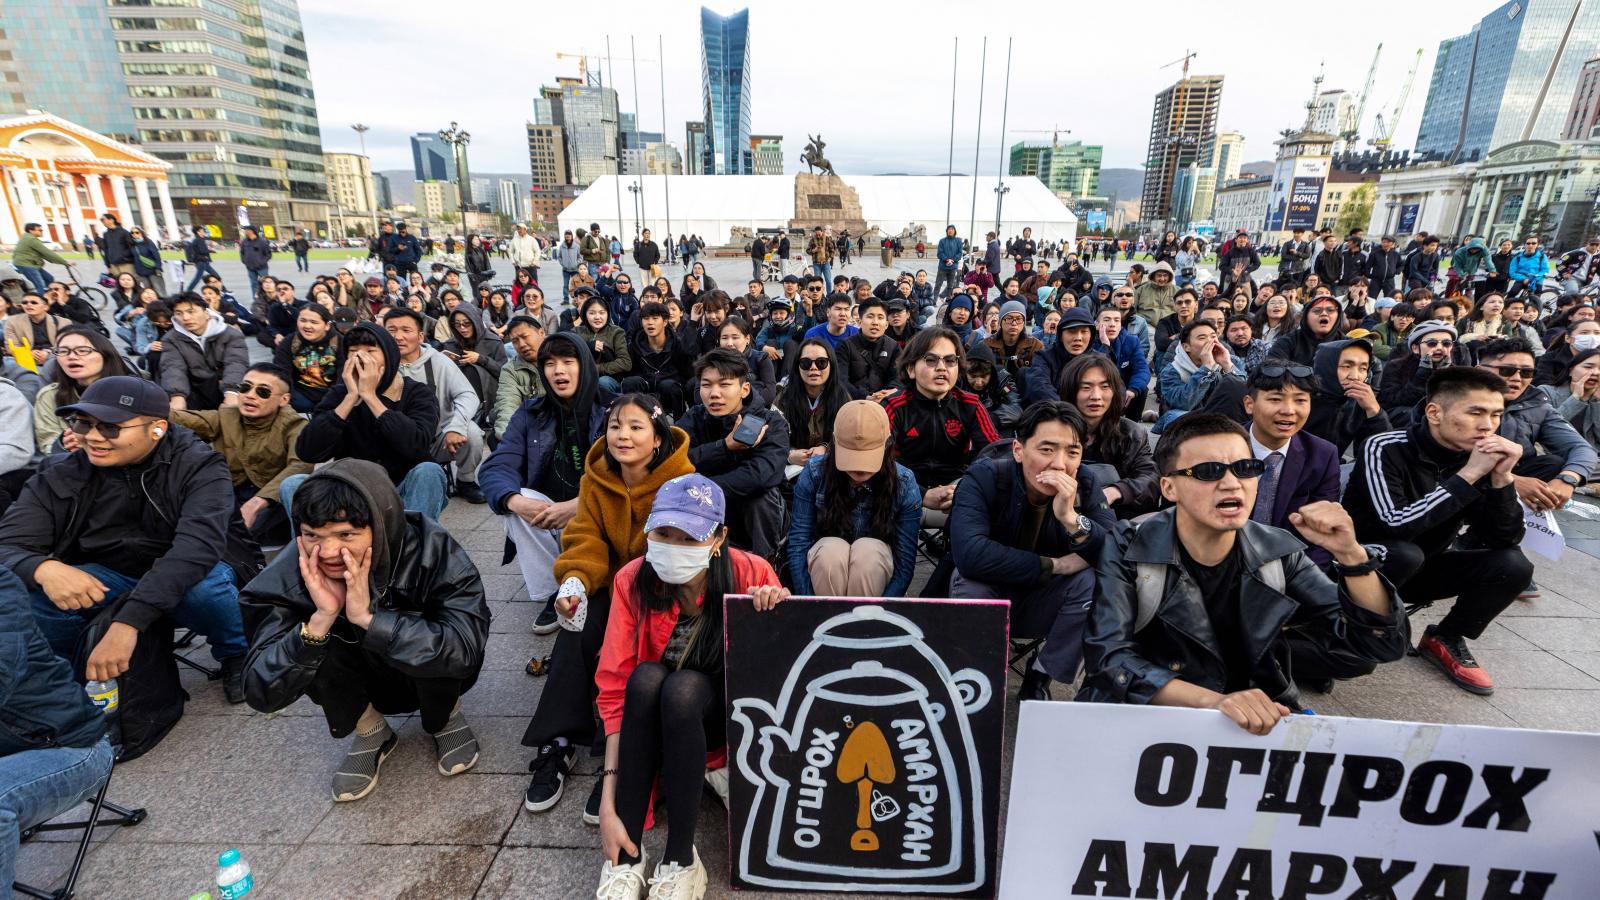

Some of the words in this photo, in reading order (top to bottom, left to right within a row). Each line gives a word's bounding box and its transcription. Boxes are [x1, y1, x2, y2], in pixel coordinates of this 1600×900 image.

[1293, 195, 1317, 204] БОНД
[794, 728, 839, 848] ОГЦРОХ
[891, 719, 938, 861] АМАРХАН
[1135, 743, 1550, 832] ОГЦРОХ
[1072, 840, 1557, 900] АМАРХАН
